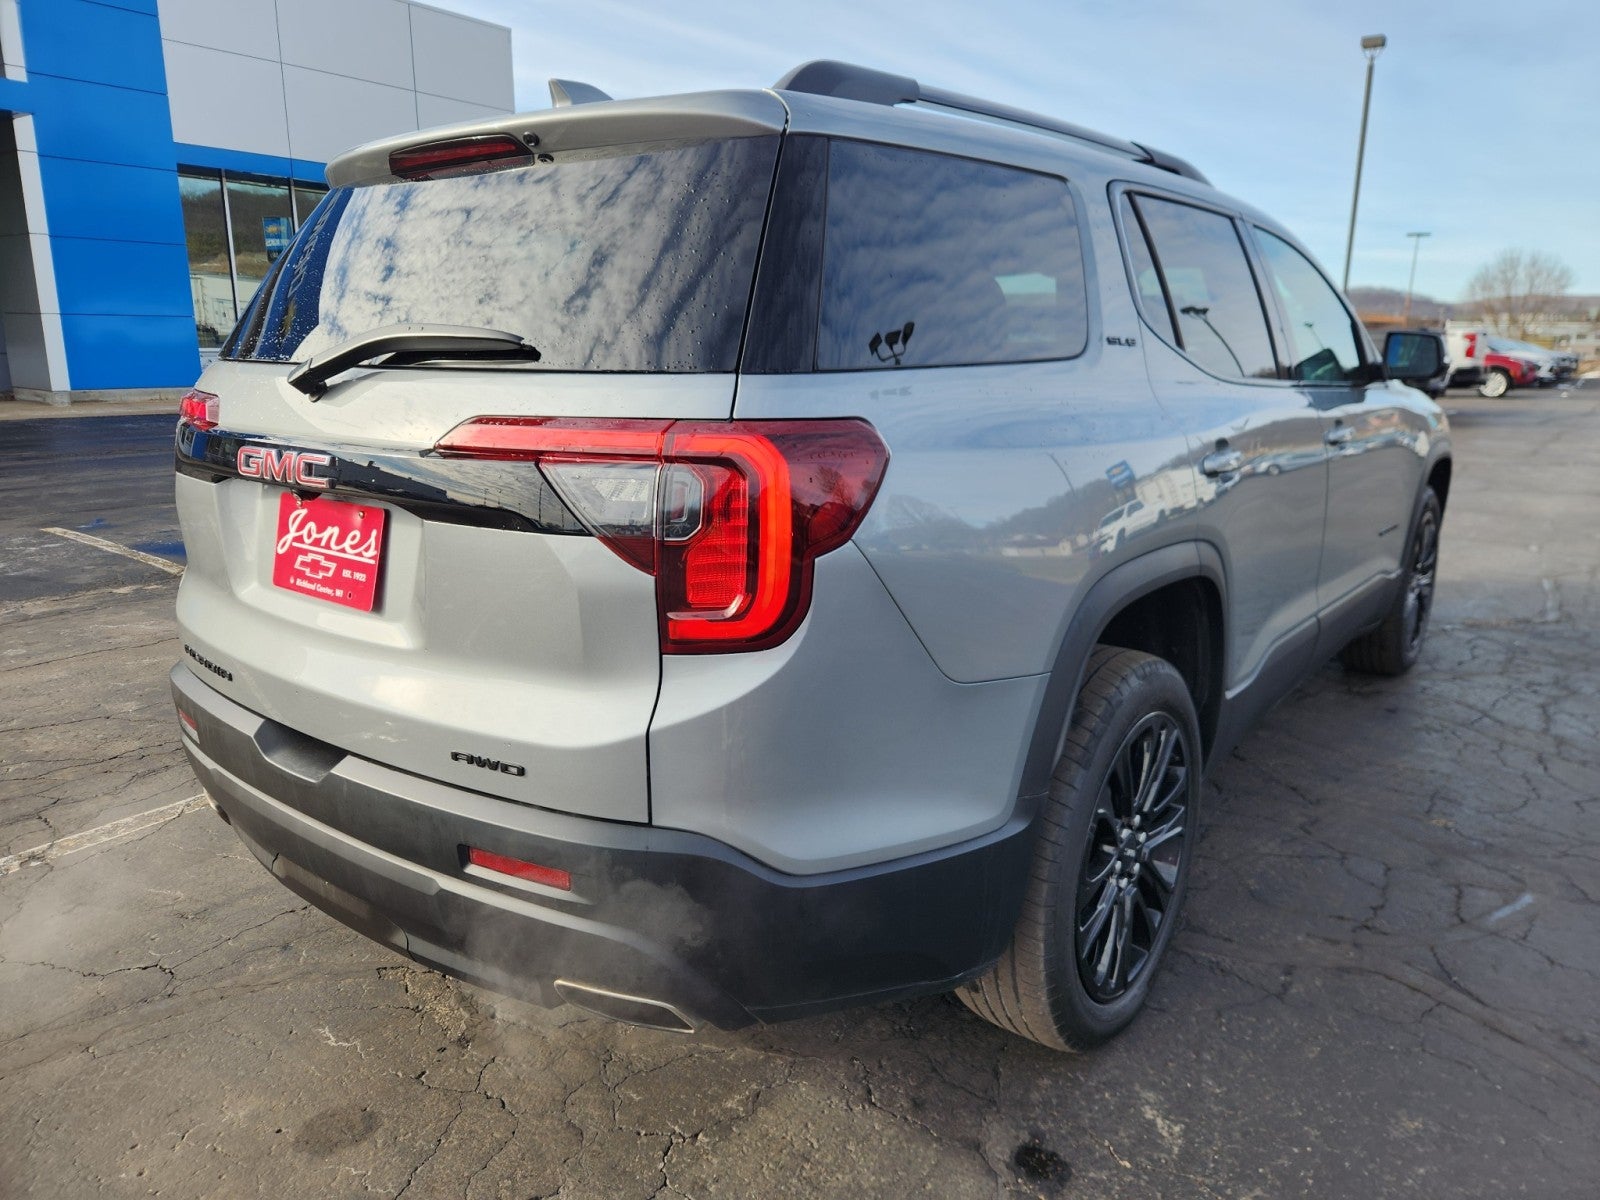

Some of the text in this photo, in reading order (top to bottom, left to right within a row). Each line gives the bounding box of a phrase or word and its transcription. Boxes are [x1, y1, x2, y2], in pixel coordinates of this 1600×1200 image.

[237, 446, 334, 489] GMC
[277, 509, 378, 557] Jones
[450, 752, 525, 776] AWD
